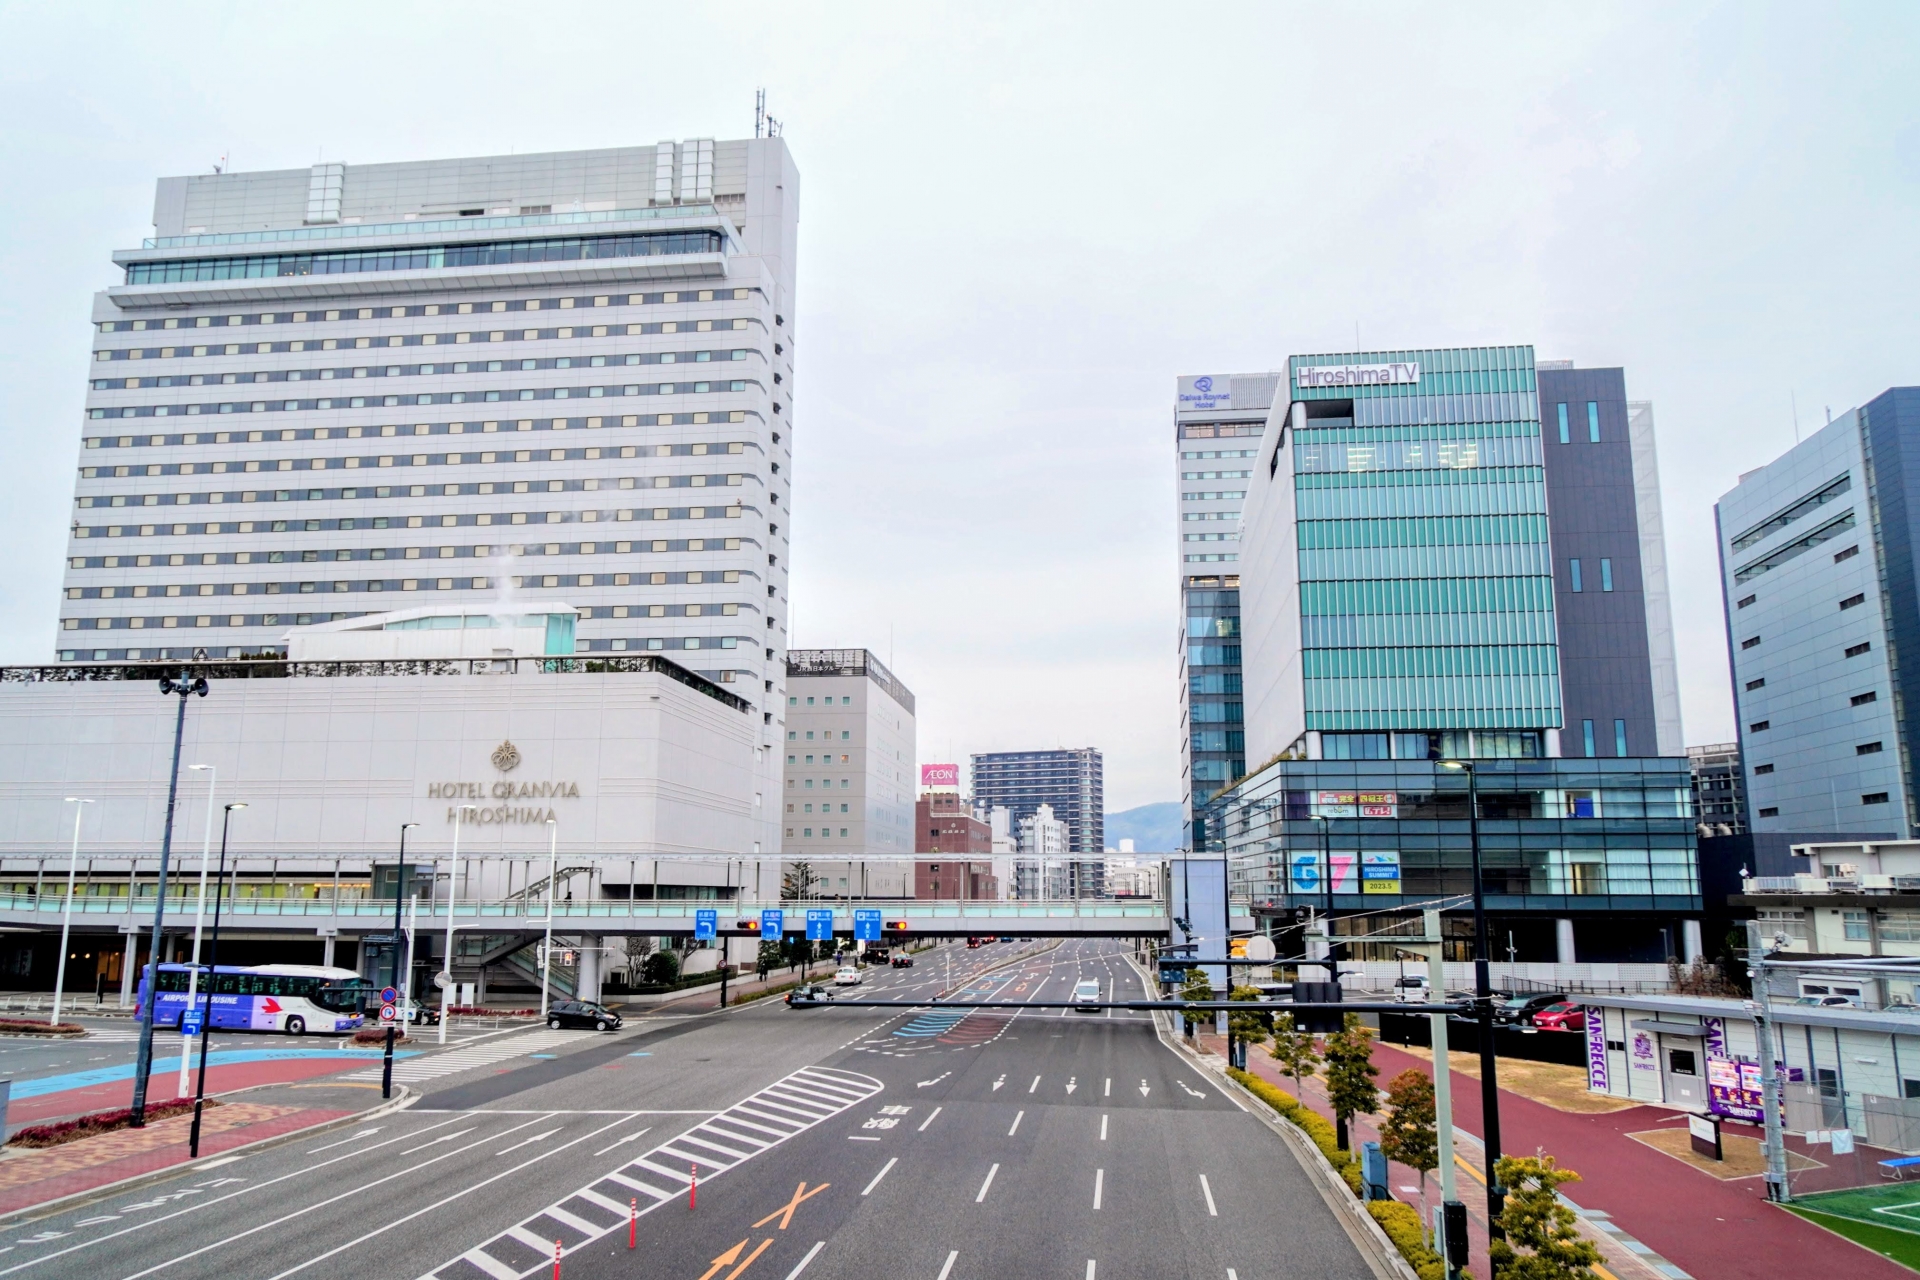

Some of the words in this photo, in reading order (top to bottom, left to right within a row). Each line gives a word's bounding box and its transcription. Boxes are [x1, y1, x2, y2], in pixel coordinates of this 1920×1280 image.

[1298, 363, 1417, 385] HiroshimaTV
[1203, 393, 1230, 401] Roynet
[428, 782, 486, 799] HOTEL
[491, 781, 580, 799] GRANVIA
[446, 807, 557, 824] HIROSHIMA
[1292, 856, 1353, 890] G7
[162, 994, 192, 1002] AIRPOR
[1586, 1006, 1607, 1089] SANFRECCE
[1633, 1062, 1655, 1071] SANFRECCE
